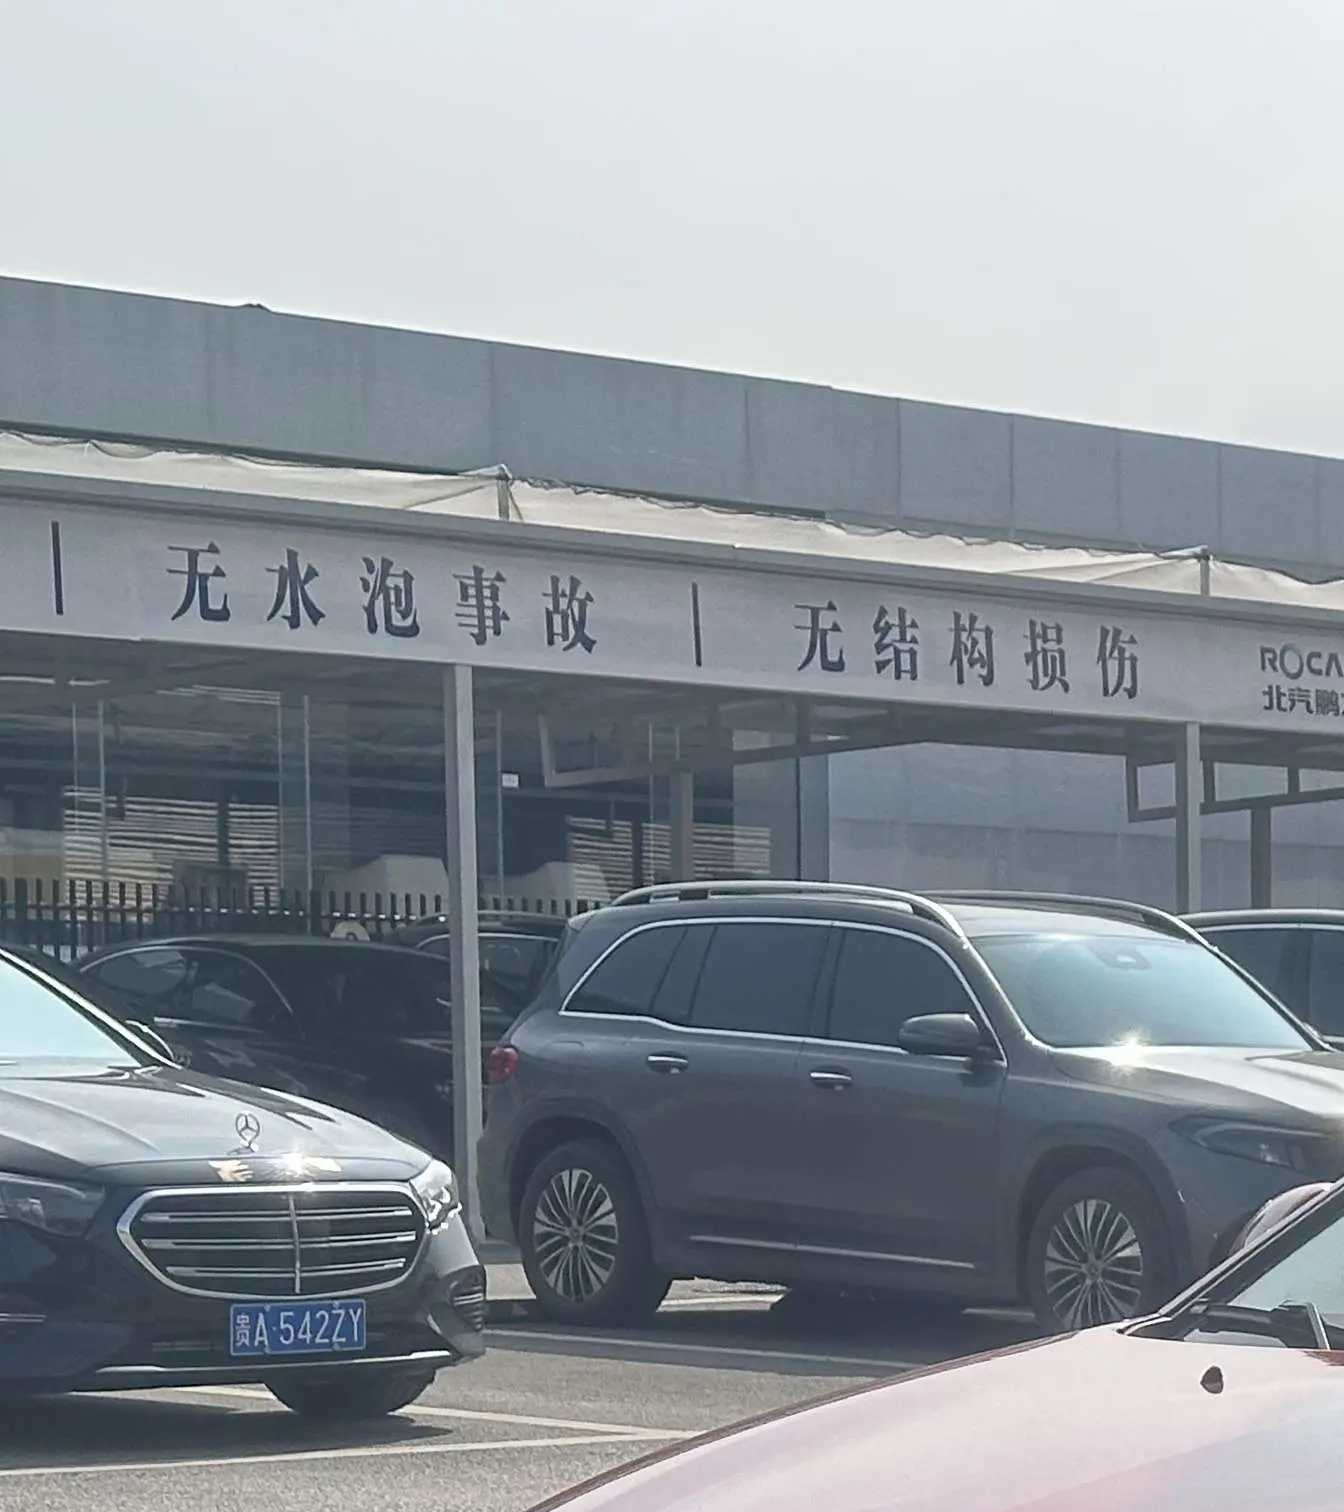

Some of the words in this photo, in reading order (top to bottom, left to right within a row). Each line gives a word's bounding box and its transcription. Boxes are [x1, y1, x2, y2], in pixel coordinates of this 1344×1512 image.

[166, 541, 598, 654] 无水泡事故
[793, 600, 1140, 701] 无结构损伤
